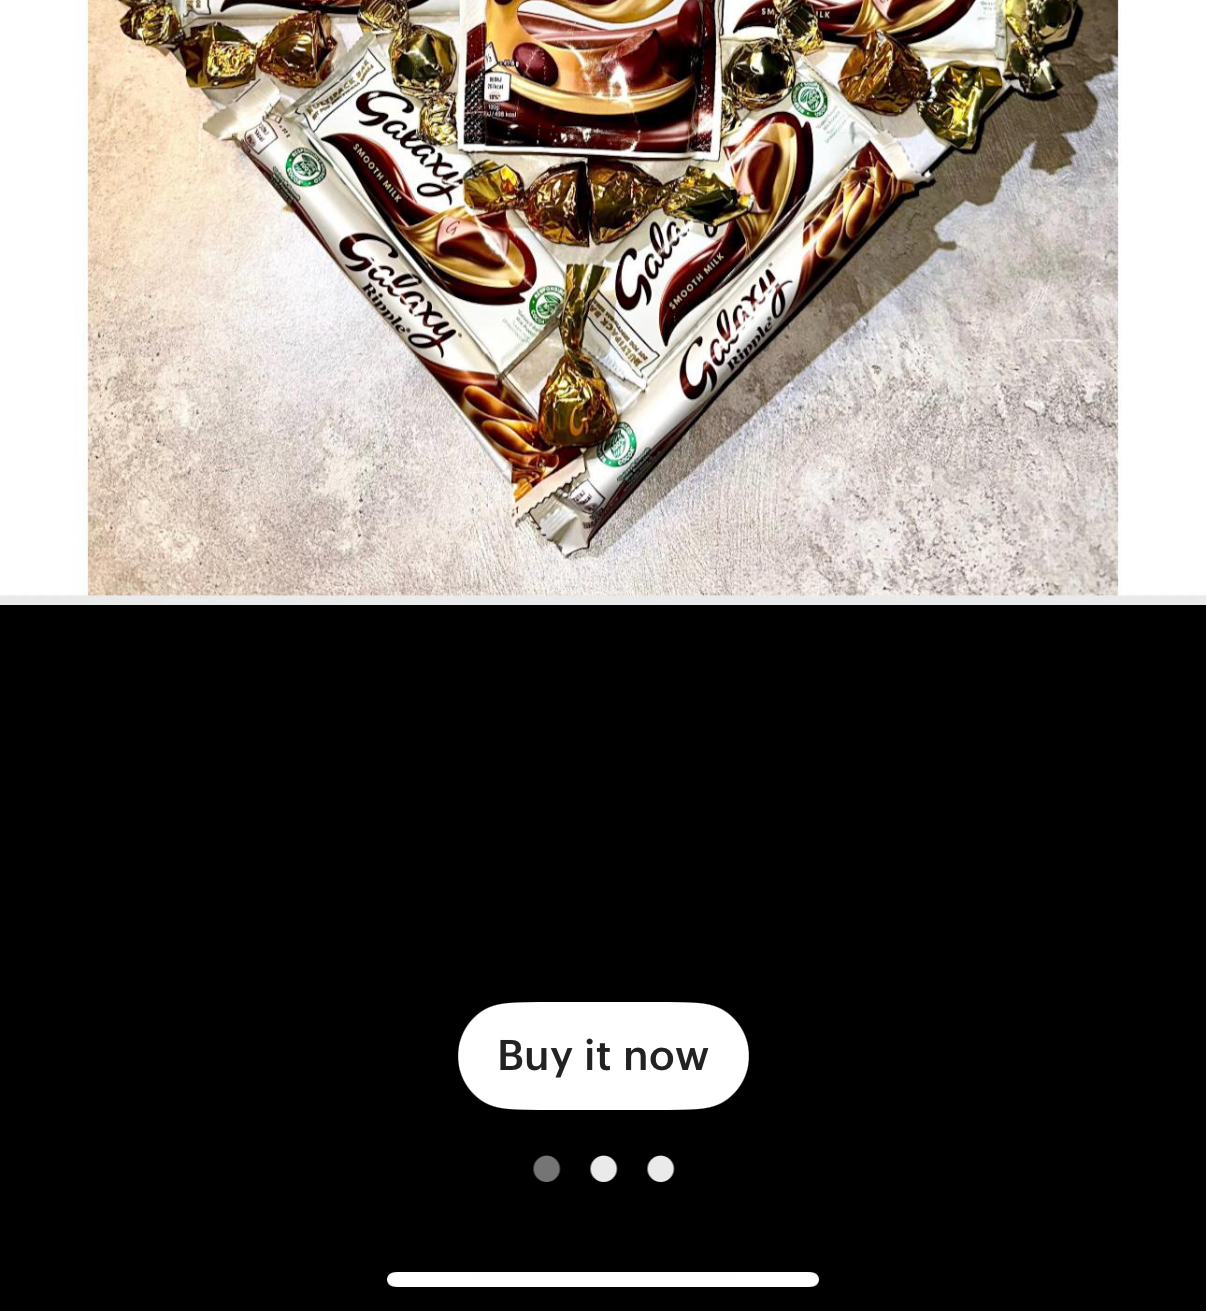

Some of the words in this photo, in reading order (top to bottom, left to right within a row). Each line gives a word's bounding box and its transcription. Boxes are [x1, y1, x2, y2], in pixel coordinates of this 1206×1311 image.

[812, 10, 831, 20] ILK
[352, 143, 383, 179] SMOOTH
[381, 178, 403, 204] MILK
[356, 90, 464, 206] Galaxy
[339, 232, 457, 359] Galaxy
[615, 221, 720, 311] Gala
[668, 274, 704, 311] SMOOTH
[703, 252, 725, 276] MILK
[363, 283, 406, 334] Ripple
[679, 266, 794, 401] Galaxy
[726, 318, 772, 373] Ripple
